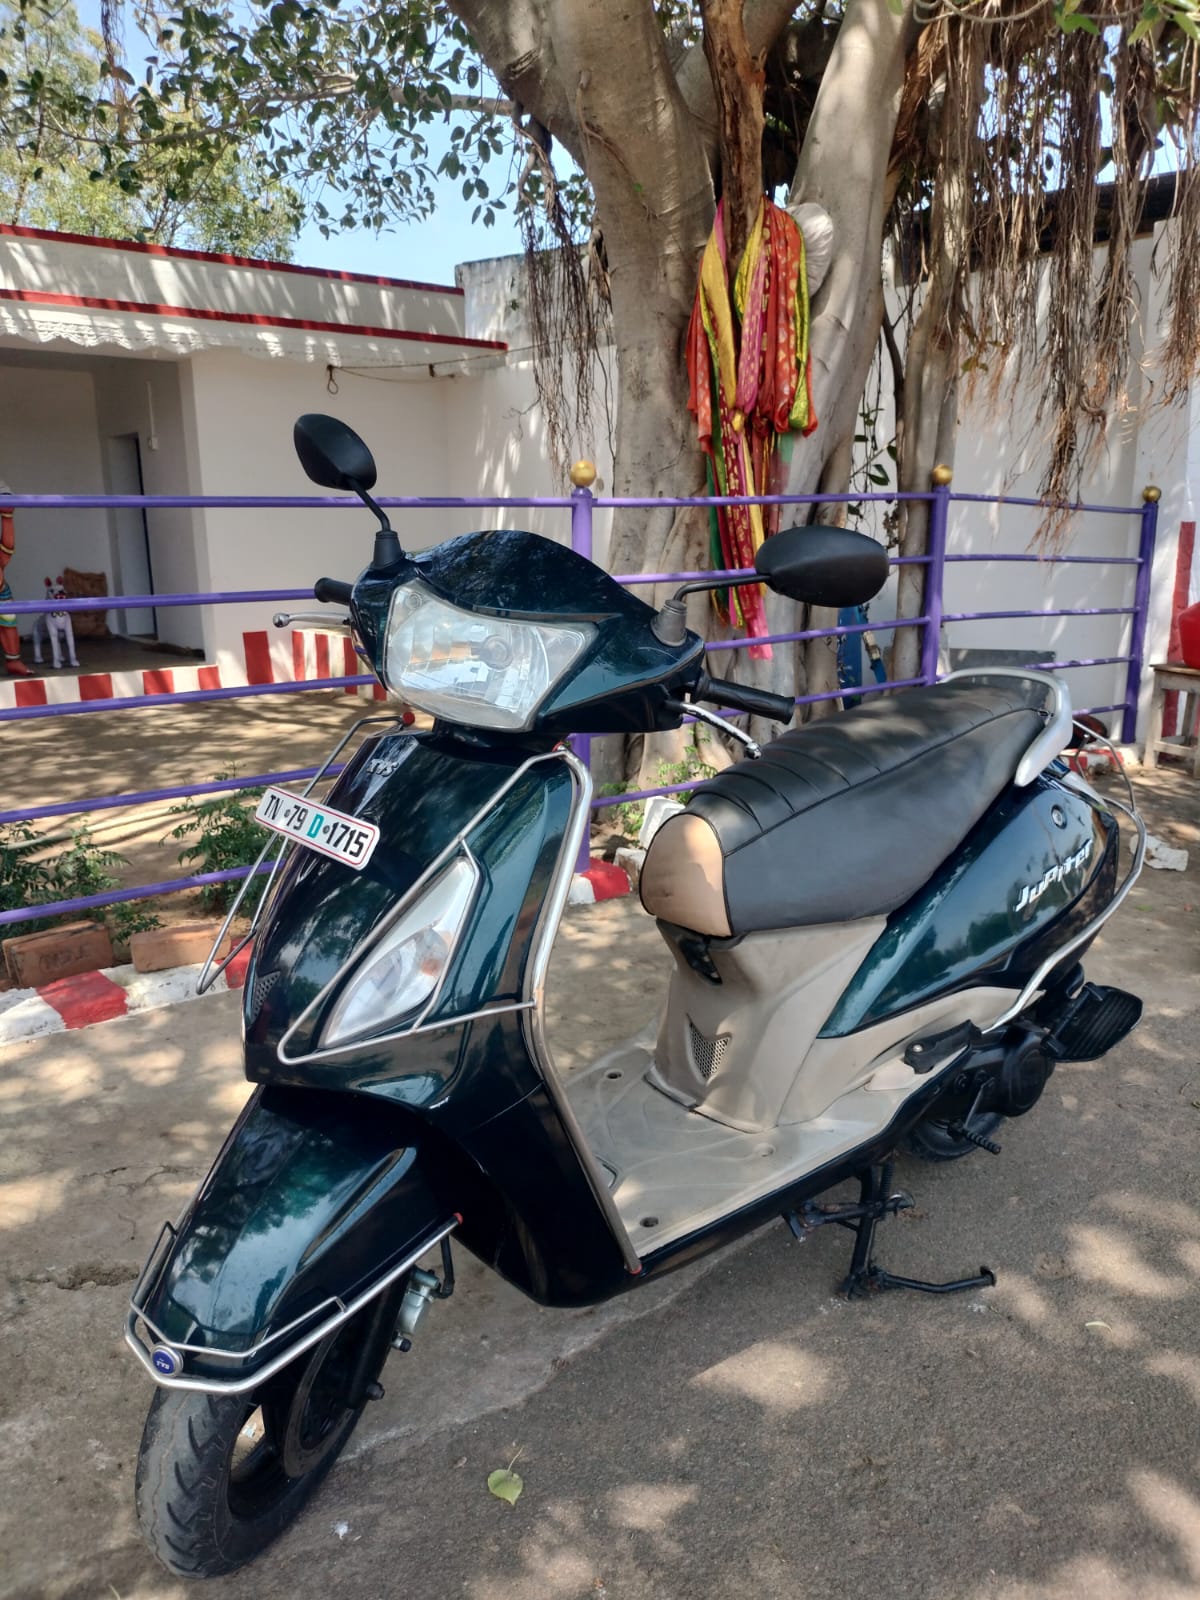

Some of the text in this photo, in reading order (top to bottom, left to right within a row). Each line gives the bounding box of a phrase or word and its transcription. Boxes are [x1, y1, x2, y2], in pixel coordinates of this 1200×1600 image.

[366, 758, 399, 777] TVS
[264, 794, 369, 858] TN 79 D 1715
